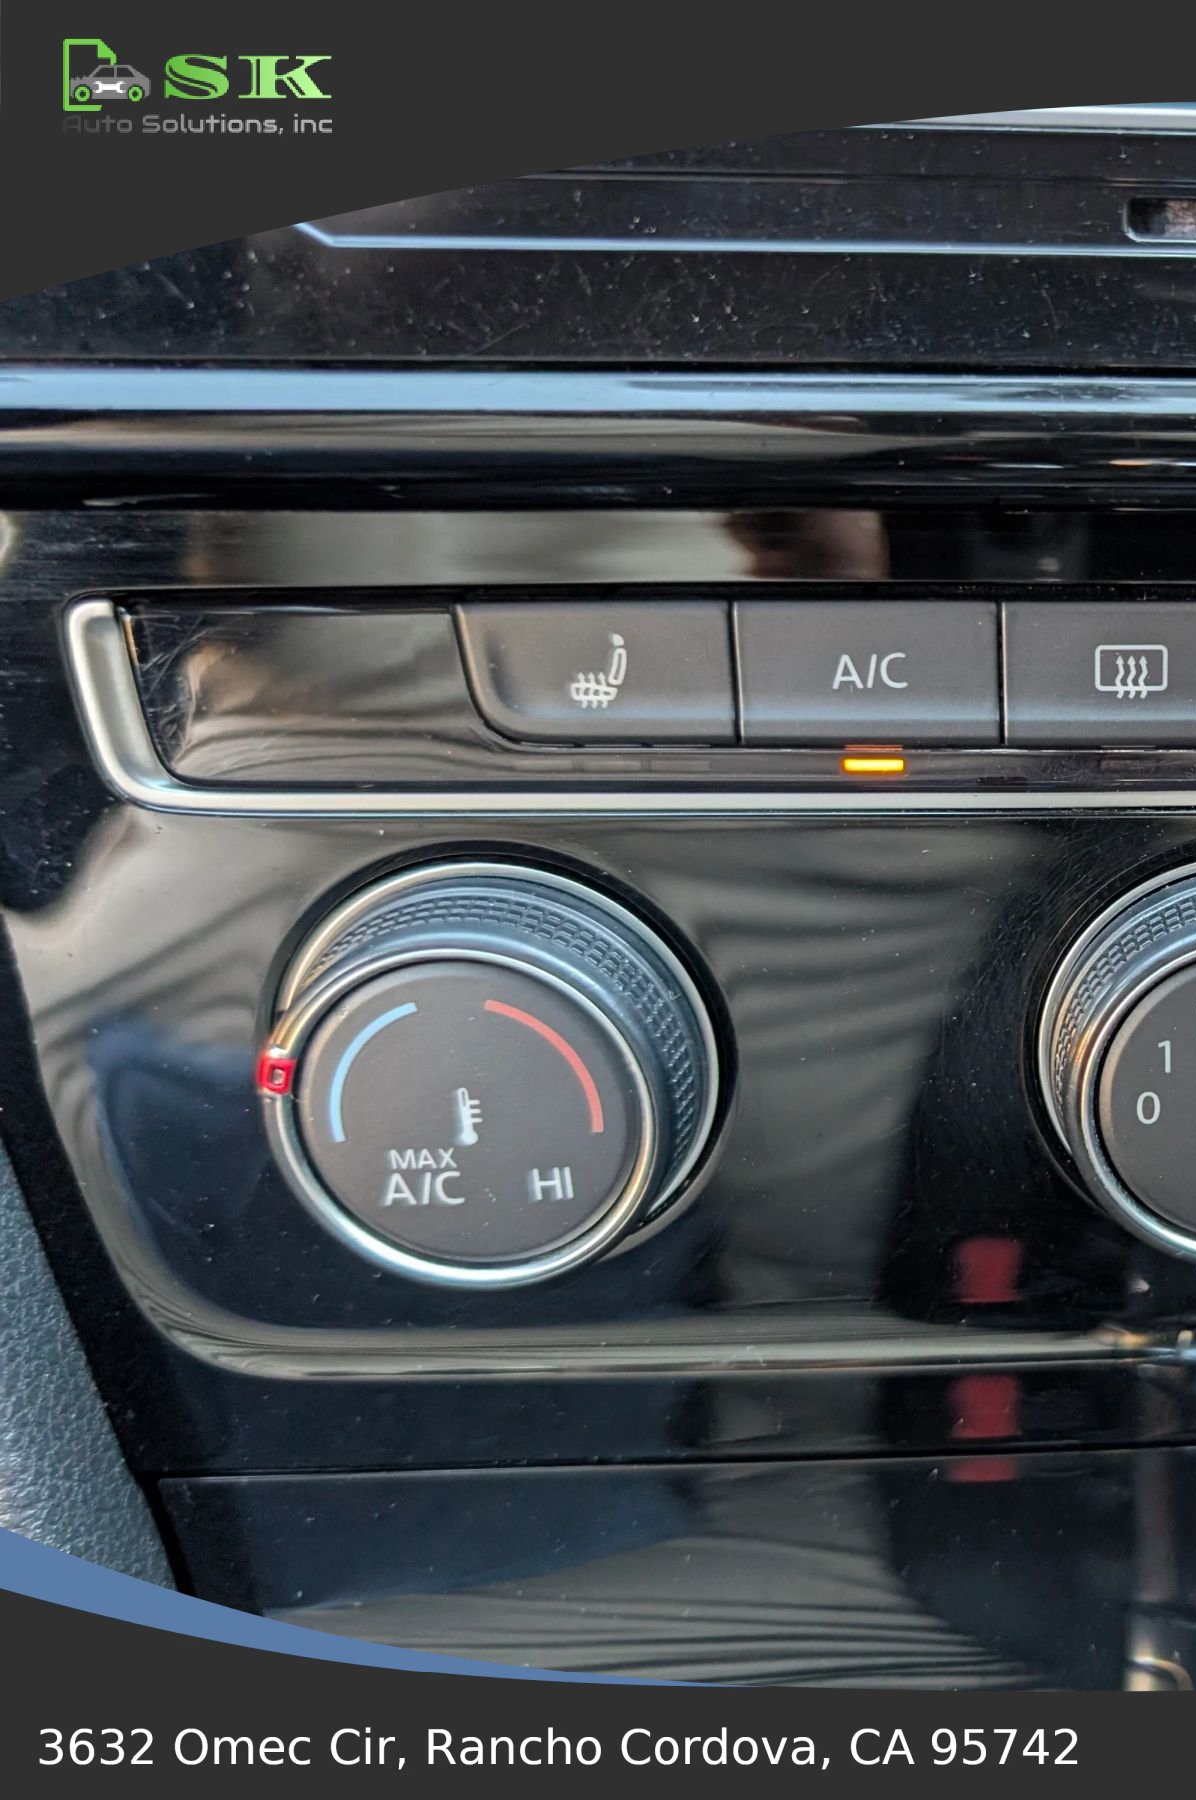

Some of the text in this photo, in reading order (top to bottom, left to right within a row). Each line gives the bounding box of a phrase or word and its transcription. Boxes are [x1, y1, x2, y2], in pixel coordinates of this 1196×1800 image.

[832, 653, 908, 690] A/C
[1136, 1091, 1161, 1125] 0
[1159, 1039, 1174, 1074] 1
[388, 1147, 458, 1170] MAX
[383, 1170, 466, 1207] A/C
[528, 1166, 575, 1202] HI
